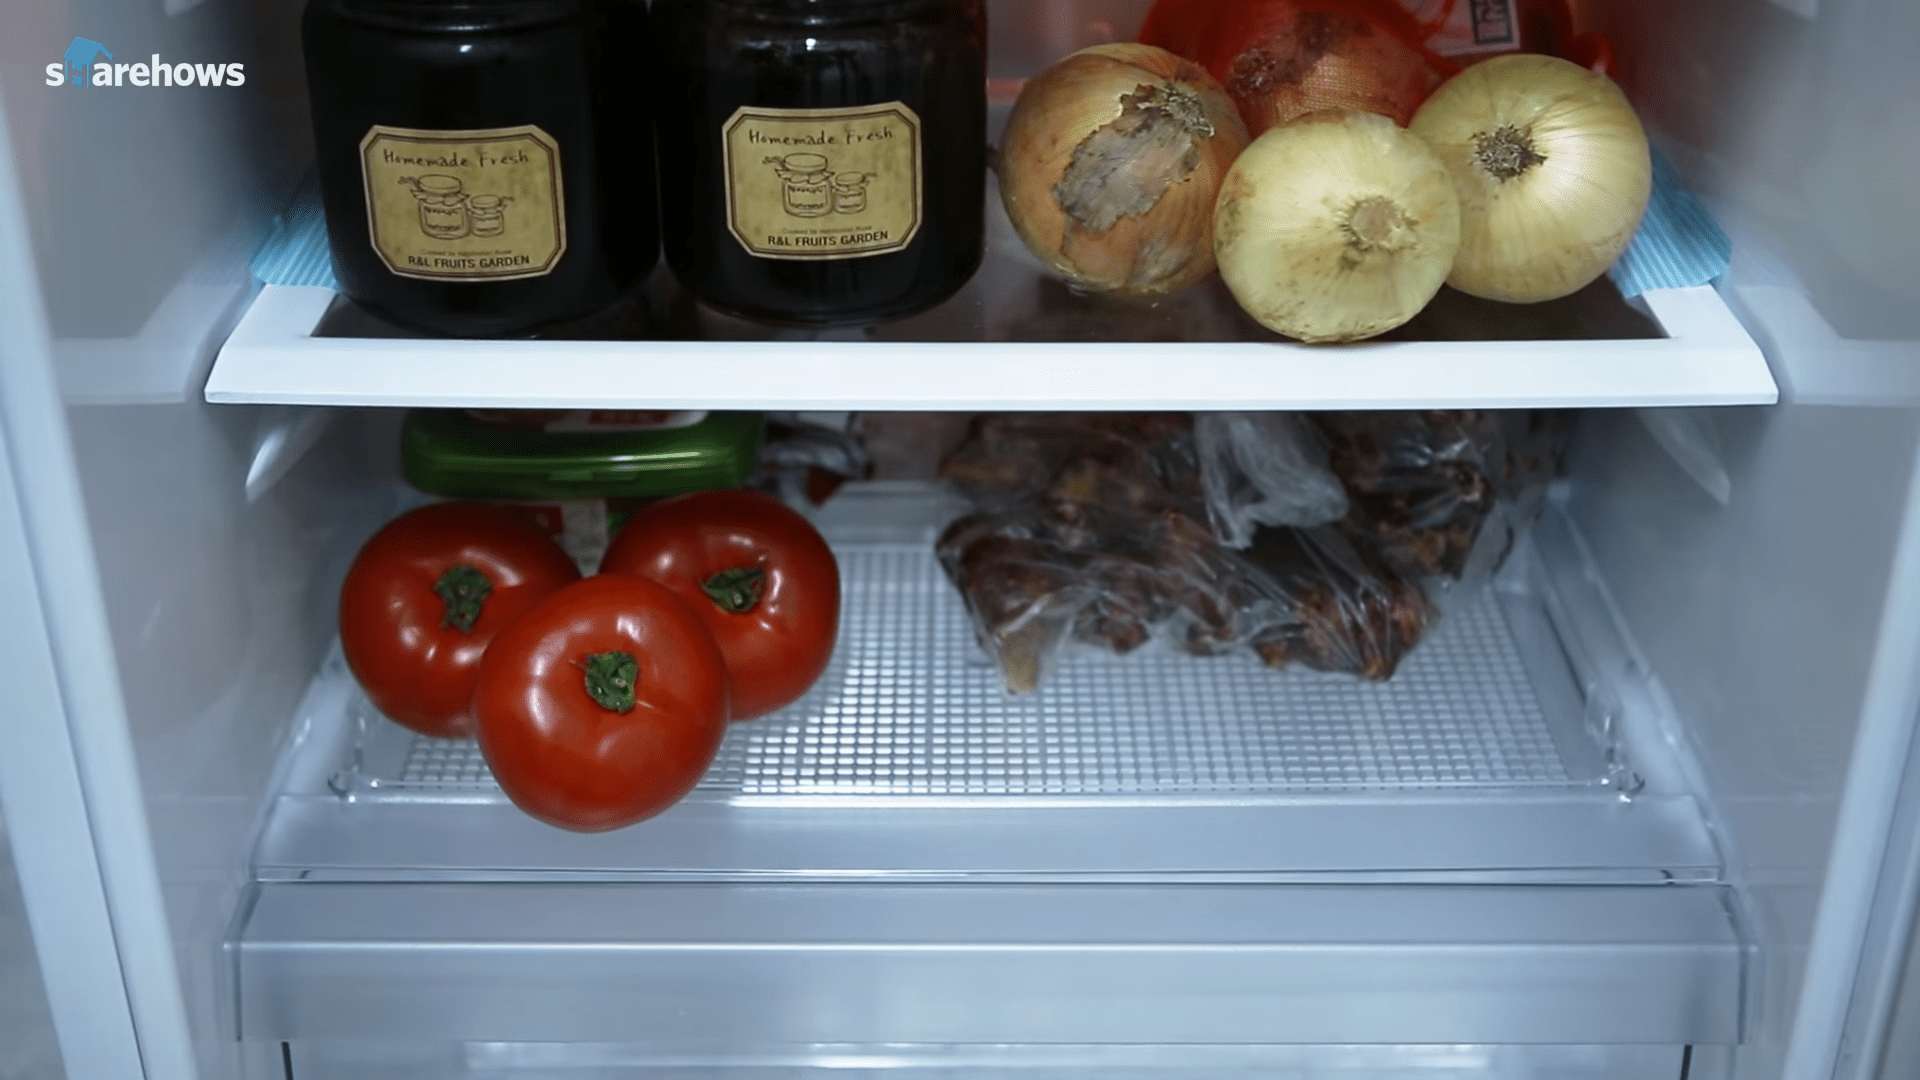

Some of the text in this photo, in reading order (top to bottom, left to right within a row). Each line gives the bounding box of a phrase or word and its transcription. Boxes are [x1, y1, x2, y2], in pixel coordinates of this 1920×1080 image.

[749, 126, 893, 146] Homemade Fresh
[383, 148, 529, 168] Homemade Fresh
[767, 231, 889, 247] R&L FRUITS GARDEN
[408, 255, 530, 269] R&L FRUITS GARDEN
